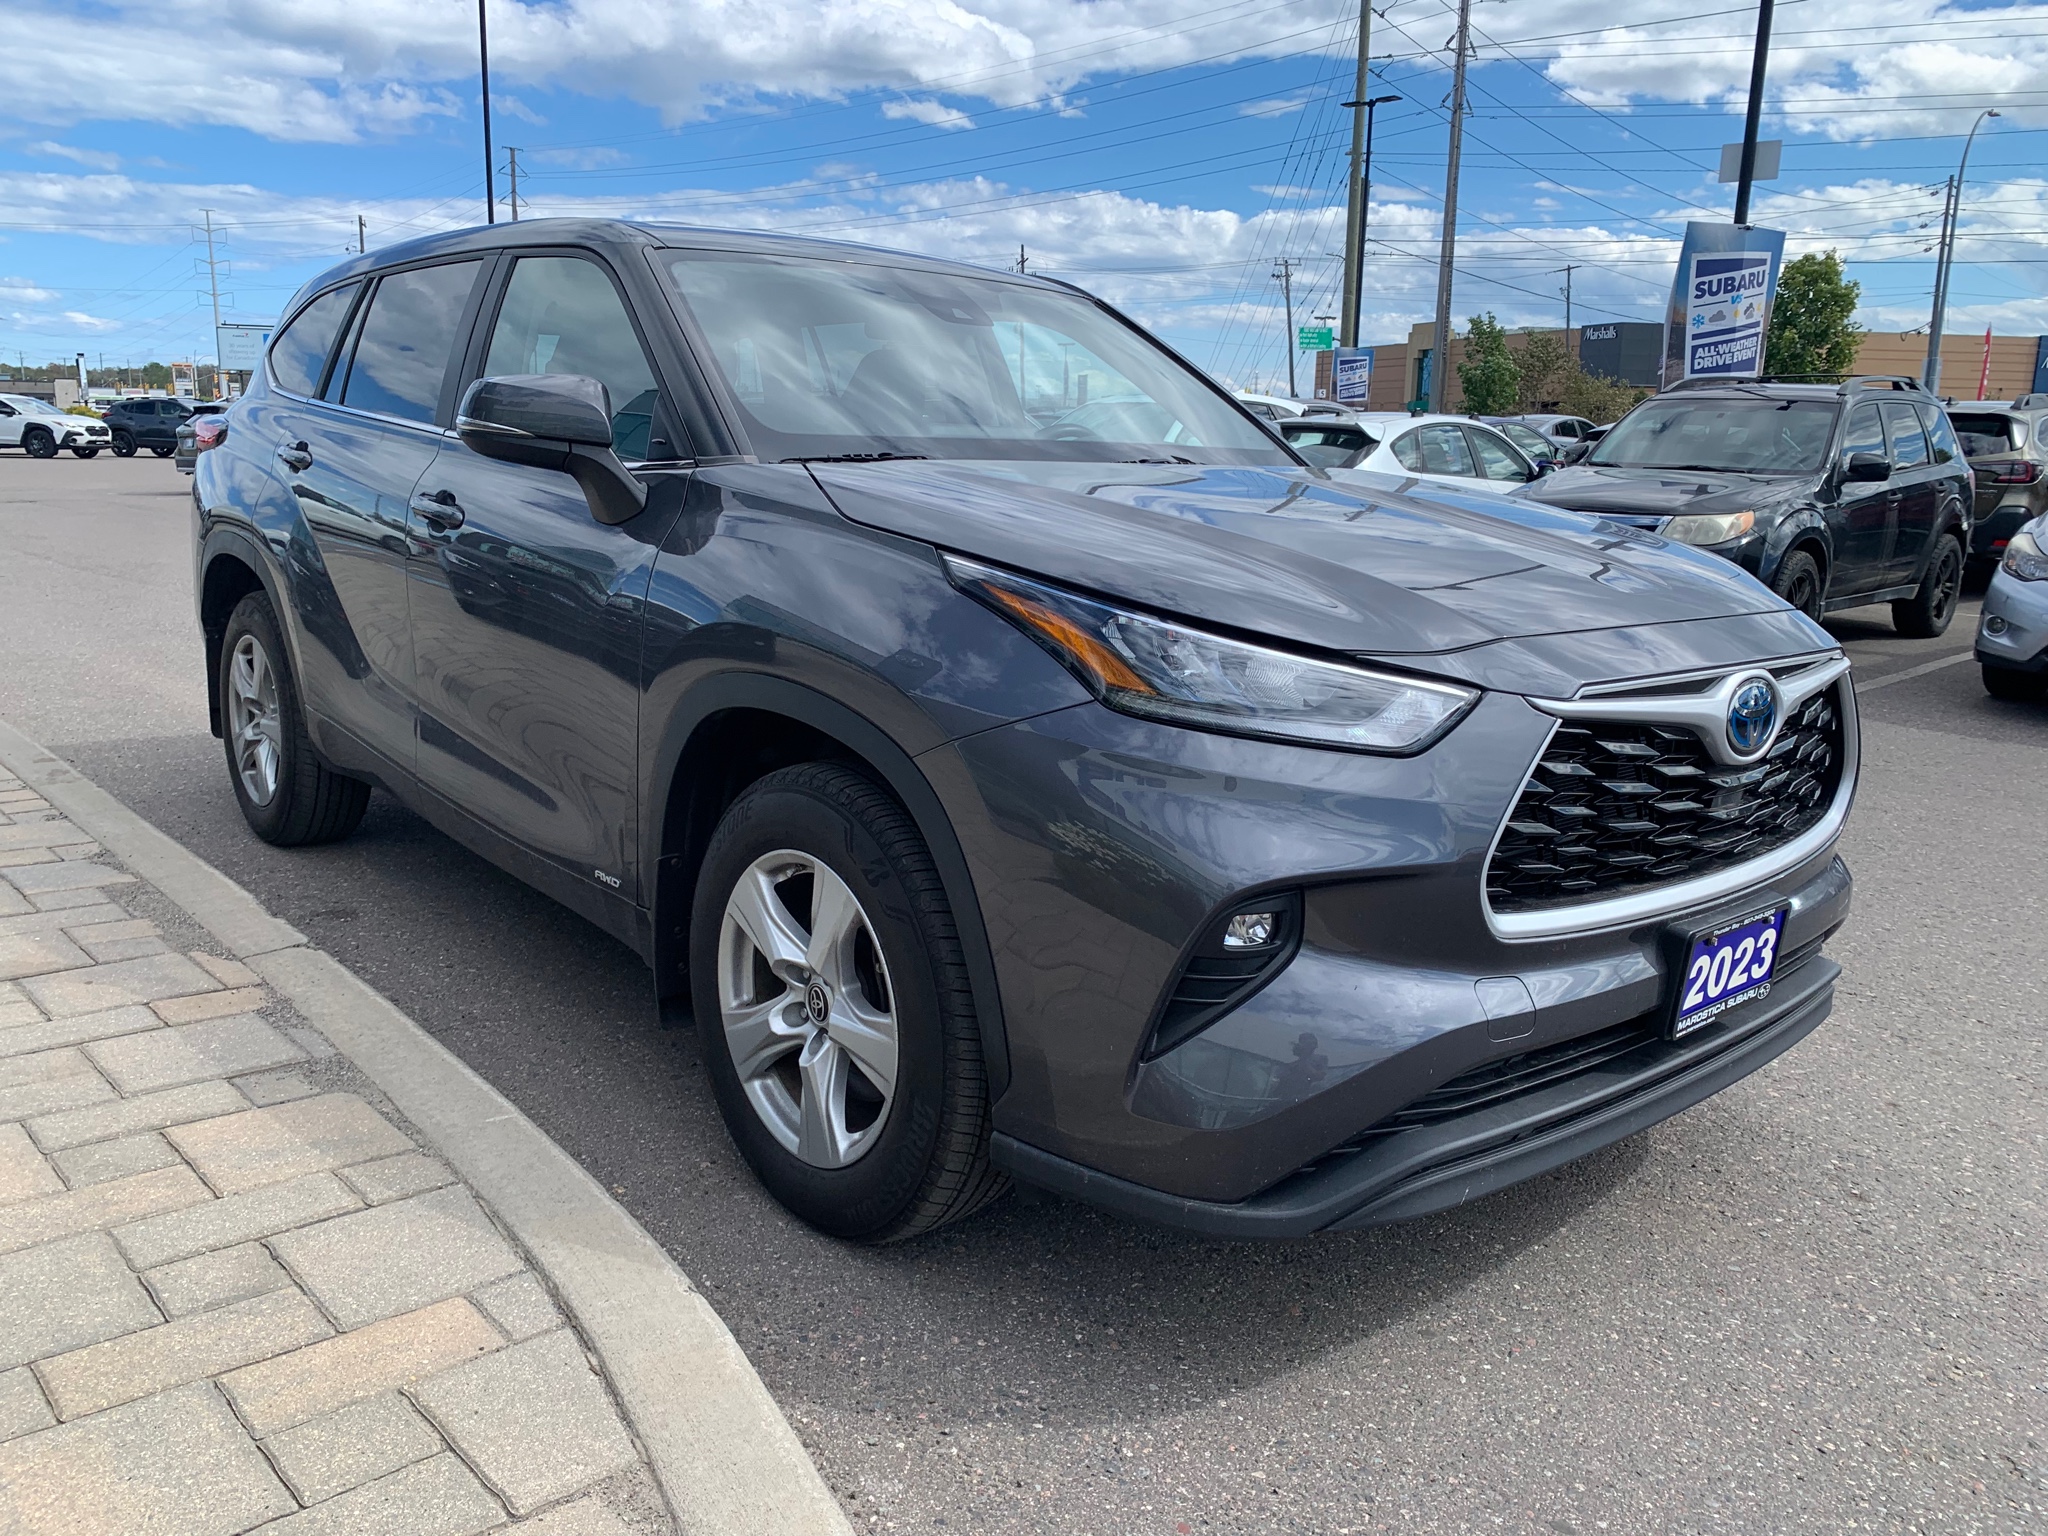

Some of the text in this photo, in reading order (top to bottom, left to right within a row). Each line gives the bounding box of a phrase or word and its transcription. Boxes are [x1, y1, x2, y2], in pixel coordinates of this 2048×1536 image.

[1693, 269, 1766, 300] SUBARU
[1583, 325, 1617, 341] Marshalls
[1339, 362, 1367, 374] SUBARU
[1693, 346, 1757, 370] DRIVE EVENT
[594, 869, 620, 888] AWD
[1682, 928, 1777, 1011] 2023
[1677, 987, 1759, 1031] MAROSTICA SUBARU
